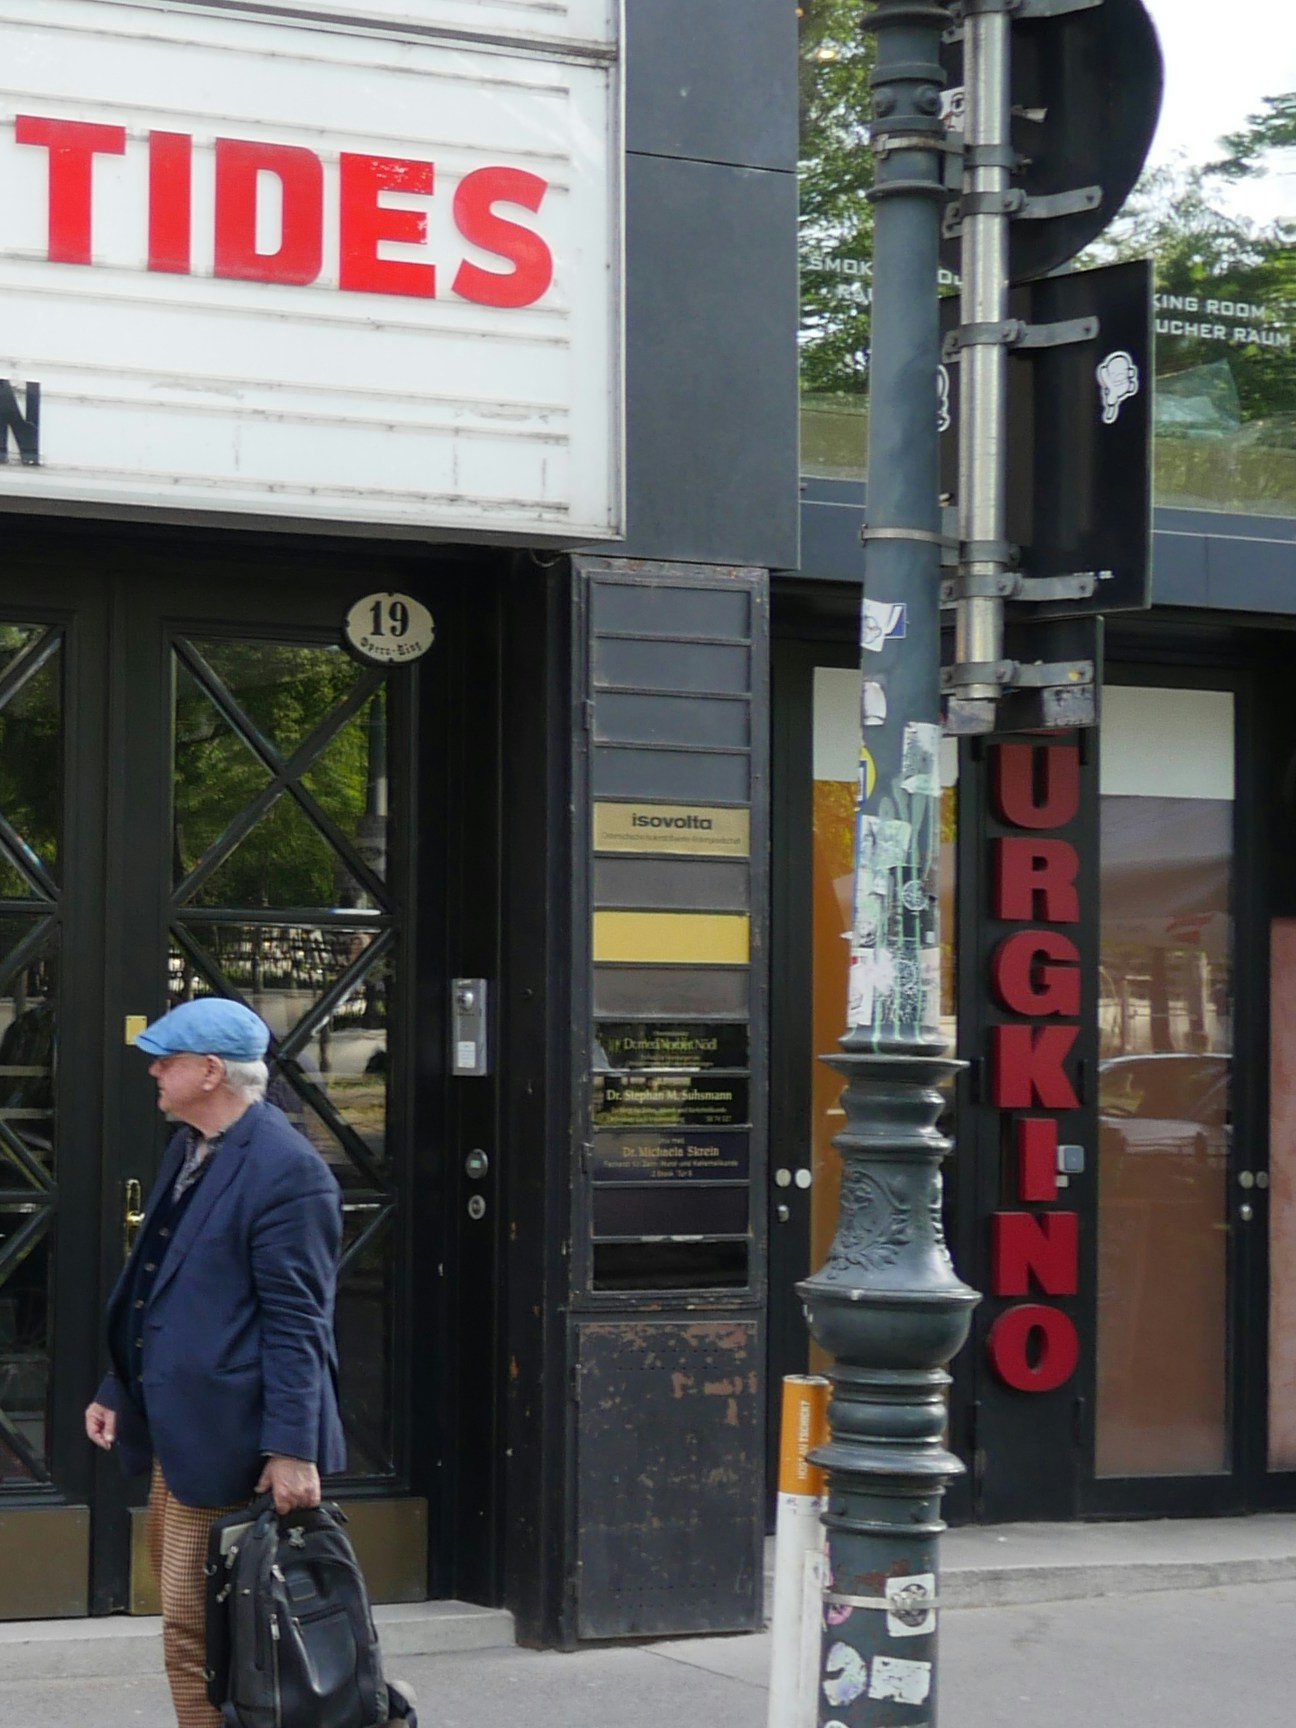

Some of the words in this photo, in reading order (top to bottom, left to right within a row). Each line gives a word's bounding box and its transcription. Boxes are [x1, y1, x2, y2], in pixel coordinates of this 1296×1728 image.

[14, 114, 555, 309] TIDES
[809, 256, 873, 276] SMOK
[1206, 299, 1266, 319] ROOM
[1155, 319, 1227, 341] UCHER
[1234, 327, 1291, 347] RAUM
[369, 600, 410, 638] 19
[631, 813, 713, 831] isovolta
[987, 733, 1081, 1392] URGKINO
[606, 1089, 622, 1101] Dr.
[624, 1089, 665, 1104] Stephan
